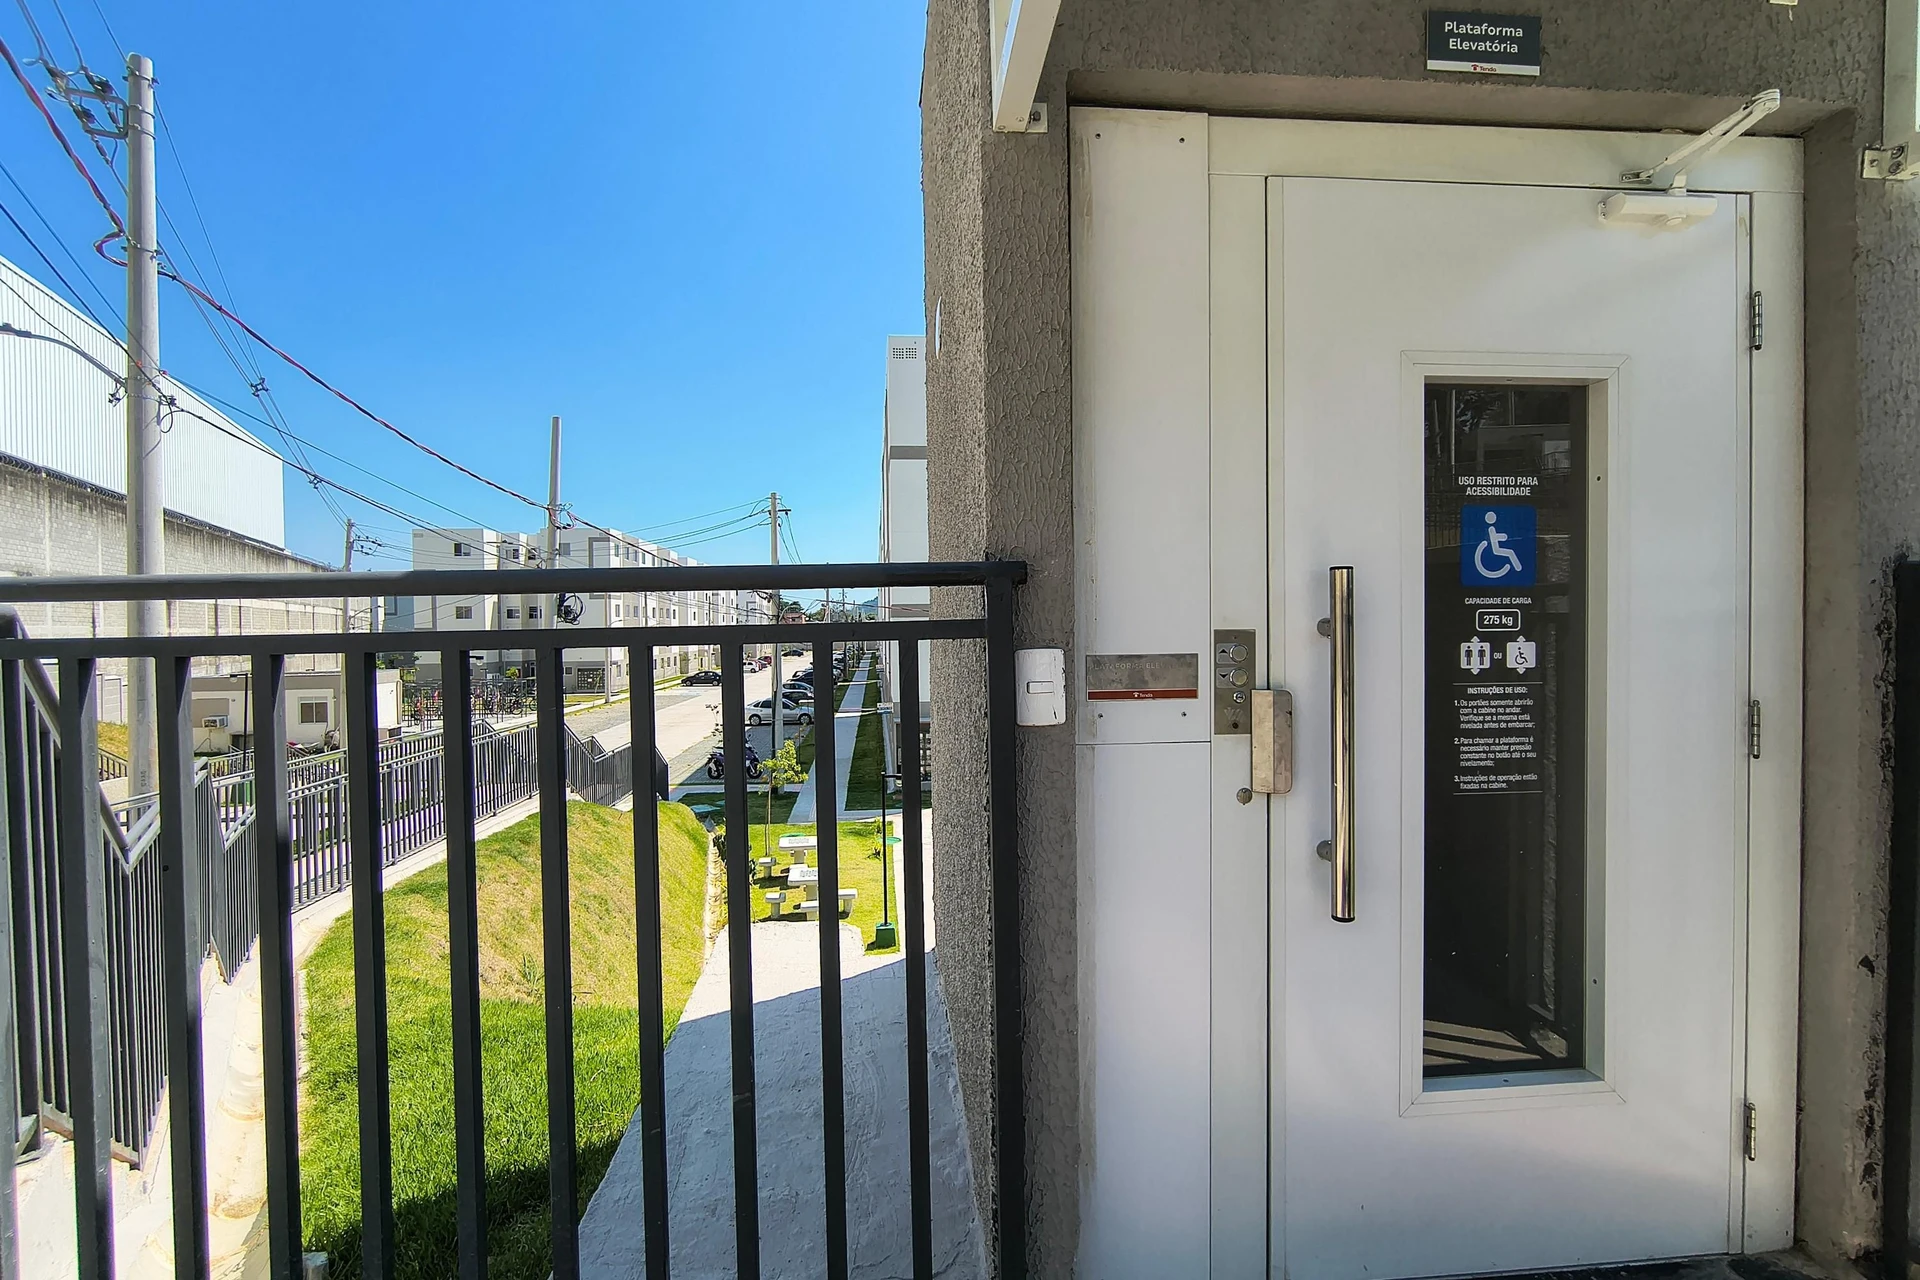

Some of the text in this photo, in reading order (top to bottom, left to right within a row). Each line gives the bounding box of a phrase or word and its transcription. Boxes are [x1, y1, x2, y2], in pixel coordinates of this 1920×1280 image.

[1445, 21, 1523, 37] Plataforma
[1449, 38, 1518, 53] Elevatória
[1459, 476, 1538, 485] USO RESTRITO PARA
[1466, 487, 1531, 495] ACESSIBILIDADE
[1484, 615, 1513, 626] 275 kg
[1468, 686, 1504, 695] INSTRUÇÕES
[1497, 774, 1522, 782] operação
